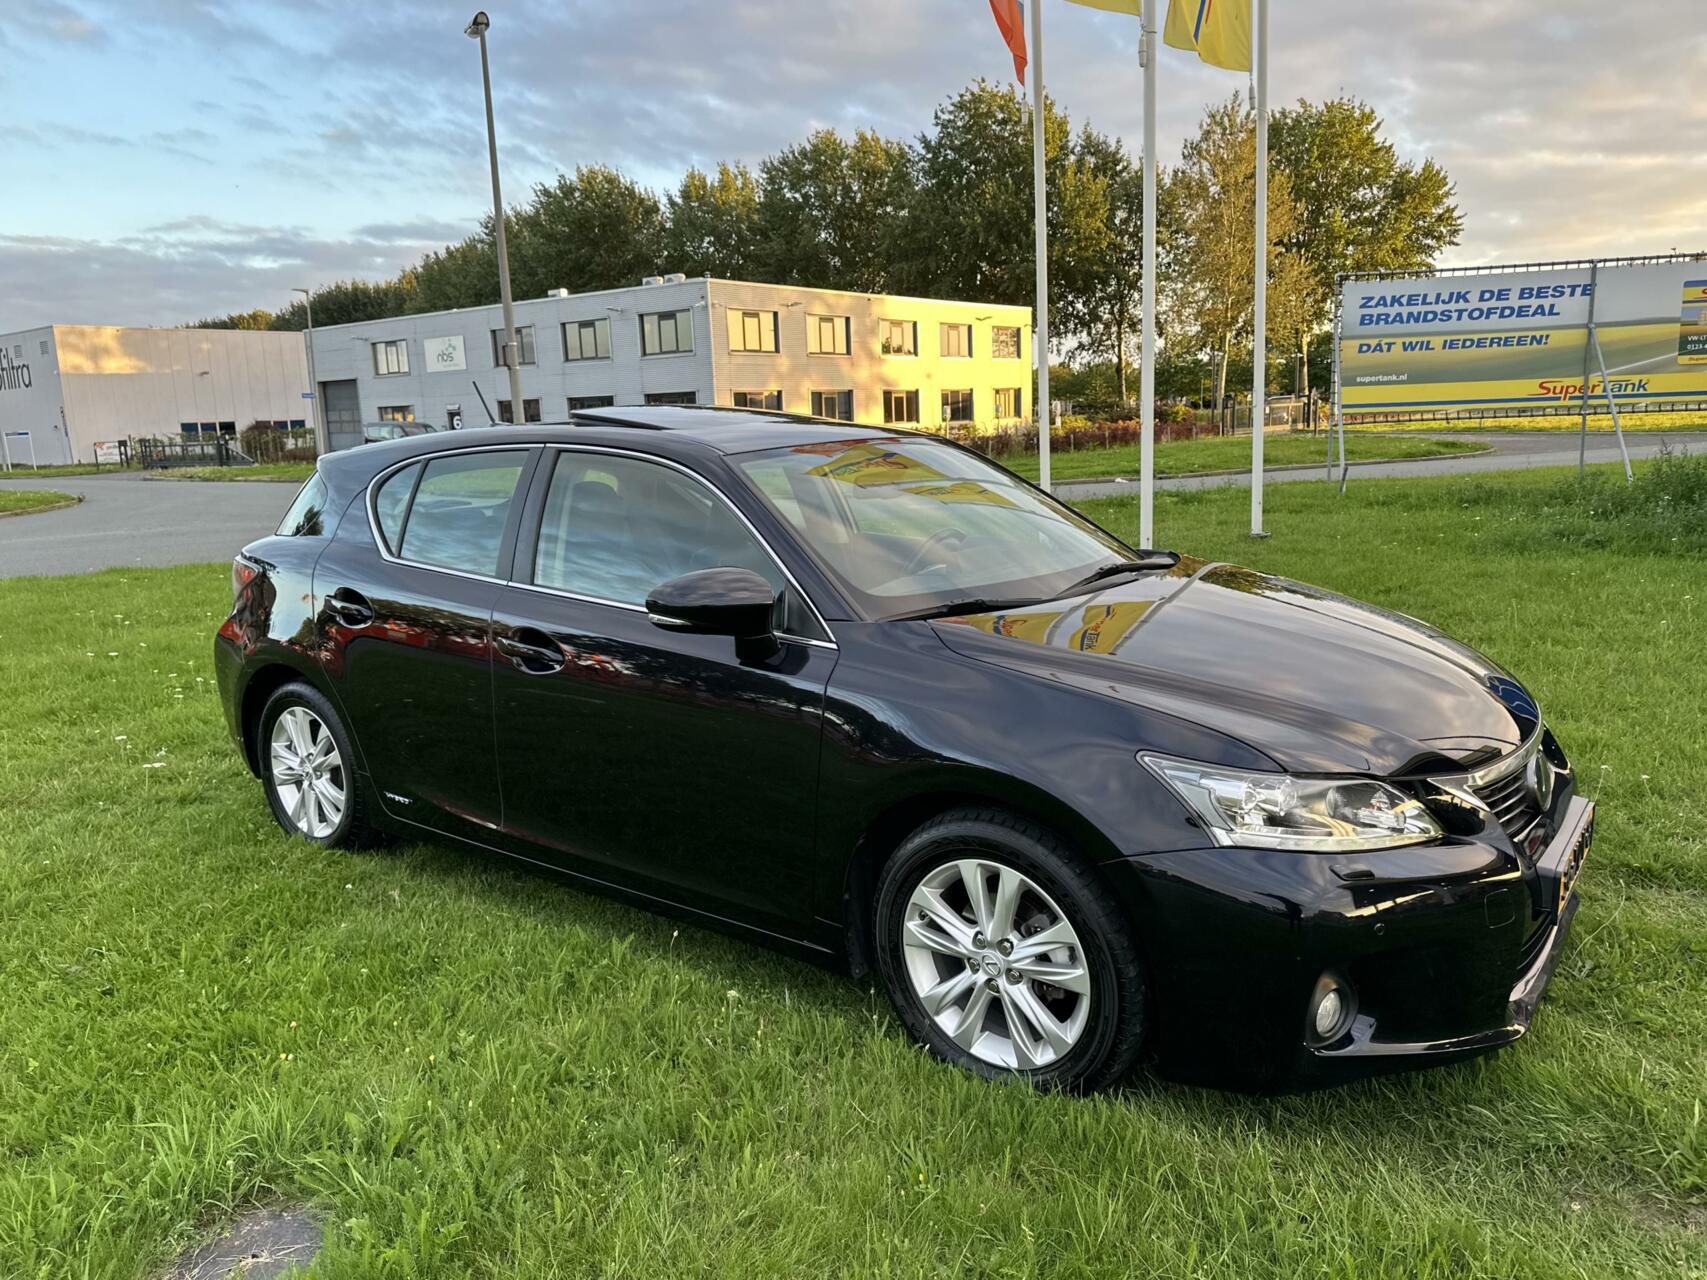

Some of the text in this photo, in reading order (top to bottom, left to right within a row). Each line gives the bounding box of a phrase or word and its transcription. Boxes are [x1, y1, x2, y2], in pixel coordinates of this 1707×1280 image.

[1358, 283, 1597, 309] ZAKELIJK DE BESTE
[1358, 303, 1561, 327] BRANDSTOFDEAL
[1357, 334, 1551, 354] DÁT WIL IEDEREEN!
[0, 347, 32, 391] filtra
[1356, 373, 1408, 383] supertank.nl
[1528, 378, 1649, 401] SuperTank
[453, 415, 462, 429] 6
